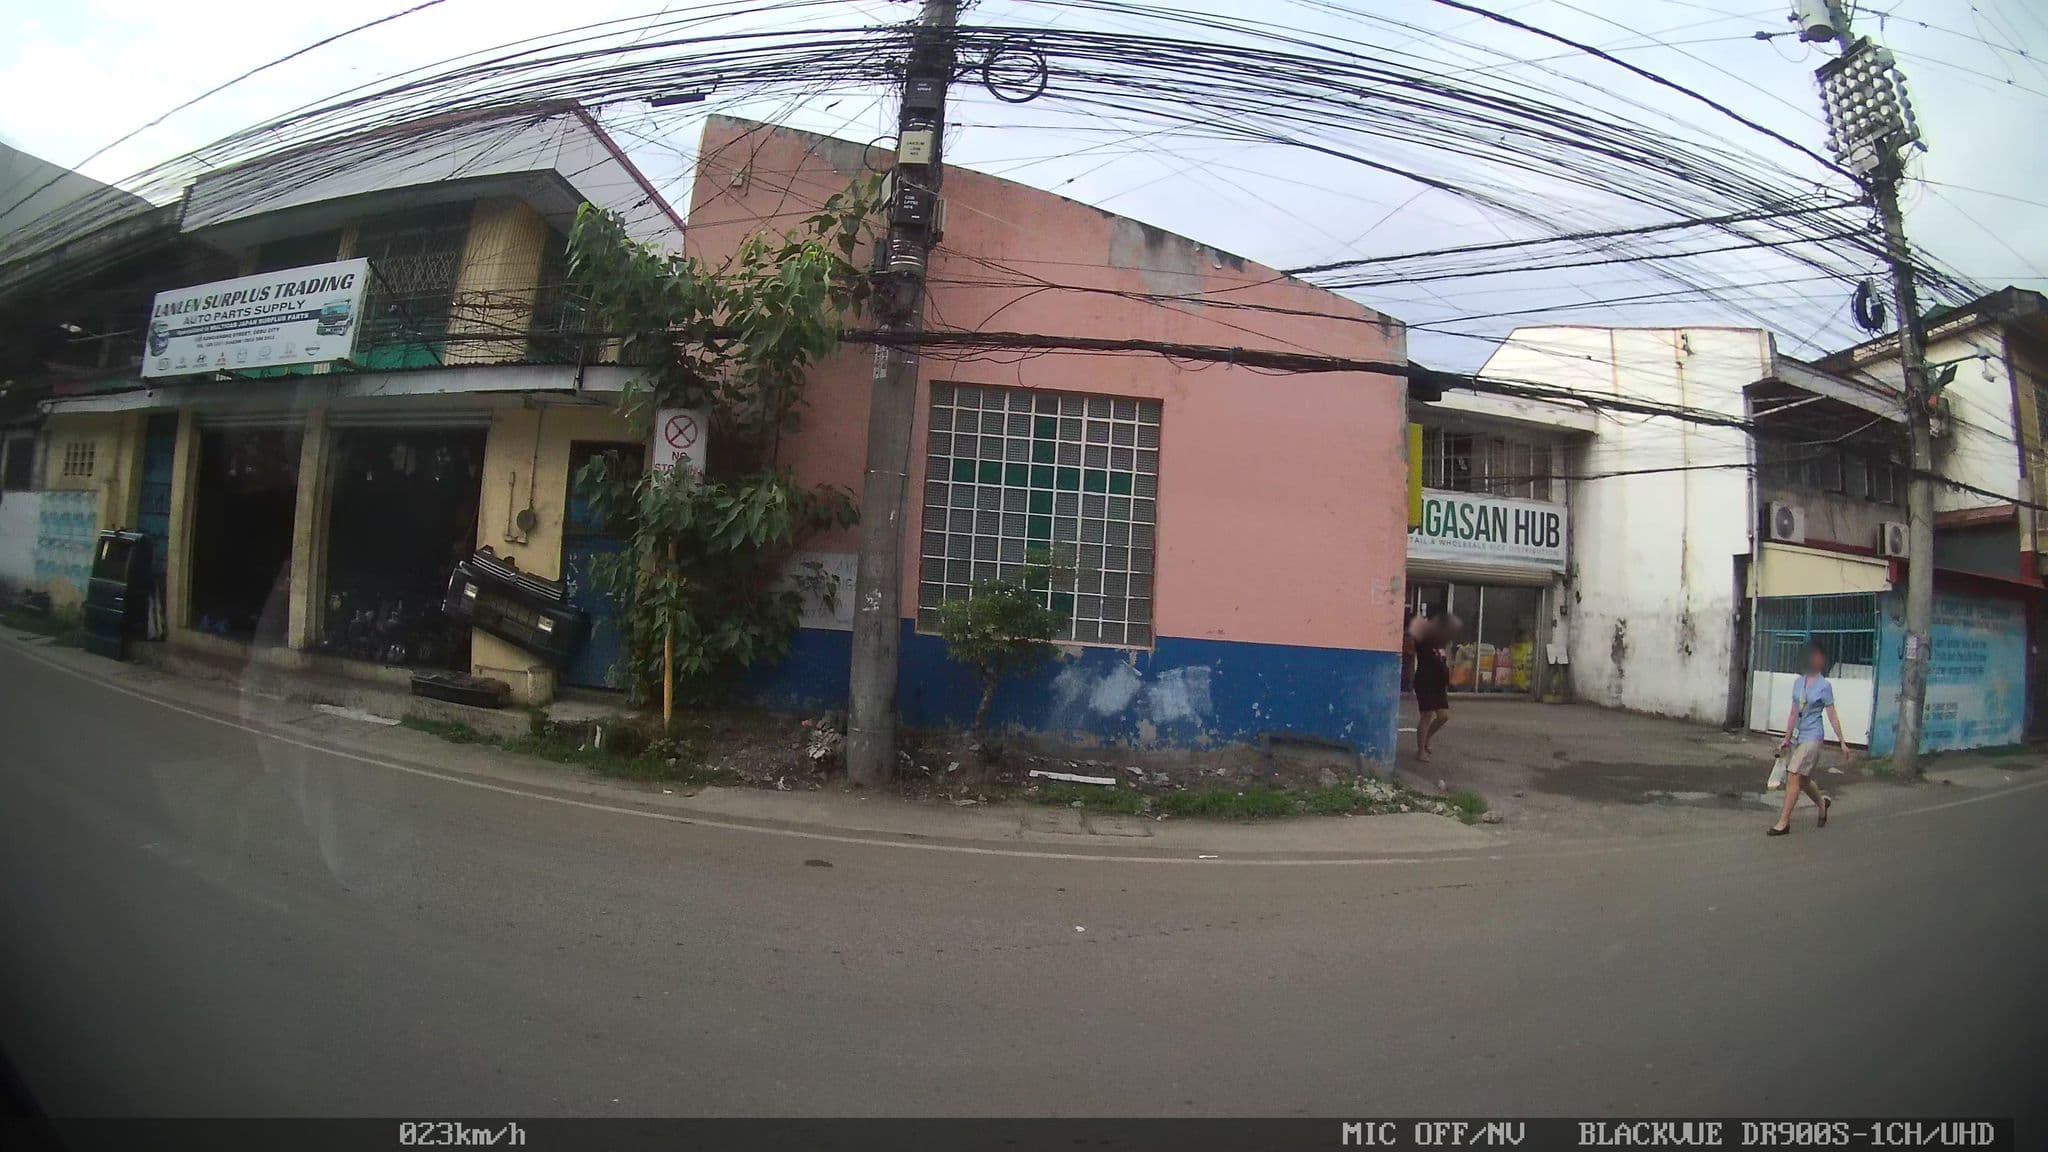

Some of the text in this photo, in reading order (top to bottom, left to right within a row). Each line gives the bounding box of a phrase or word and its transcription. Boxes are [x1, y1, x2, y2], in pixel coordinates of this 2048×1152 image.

[202, 285, 272, 310] SURPLUS
[274, 274, 355, 299] TRADING
[183, 300, 306, 325] AUTO PARTS SUPPLY
[287, 312, 309, 321] PARTS
[1515, 508, 1560, 548] HUB
